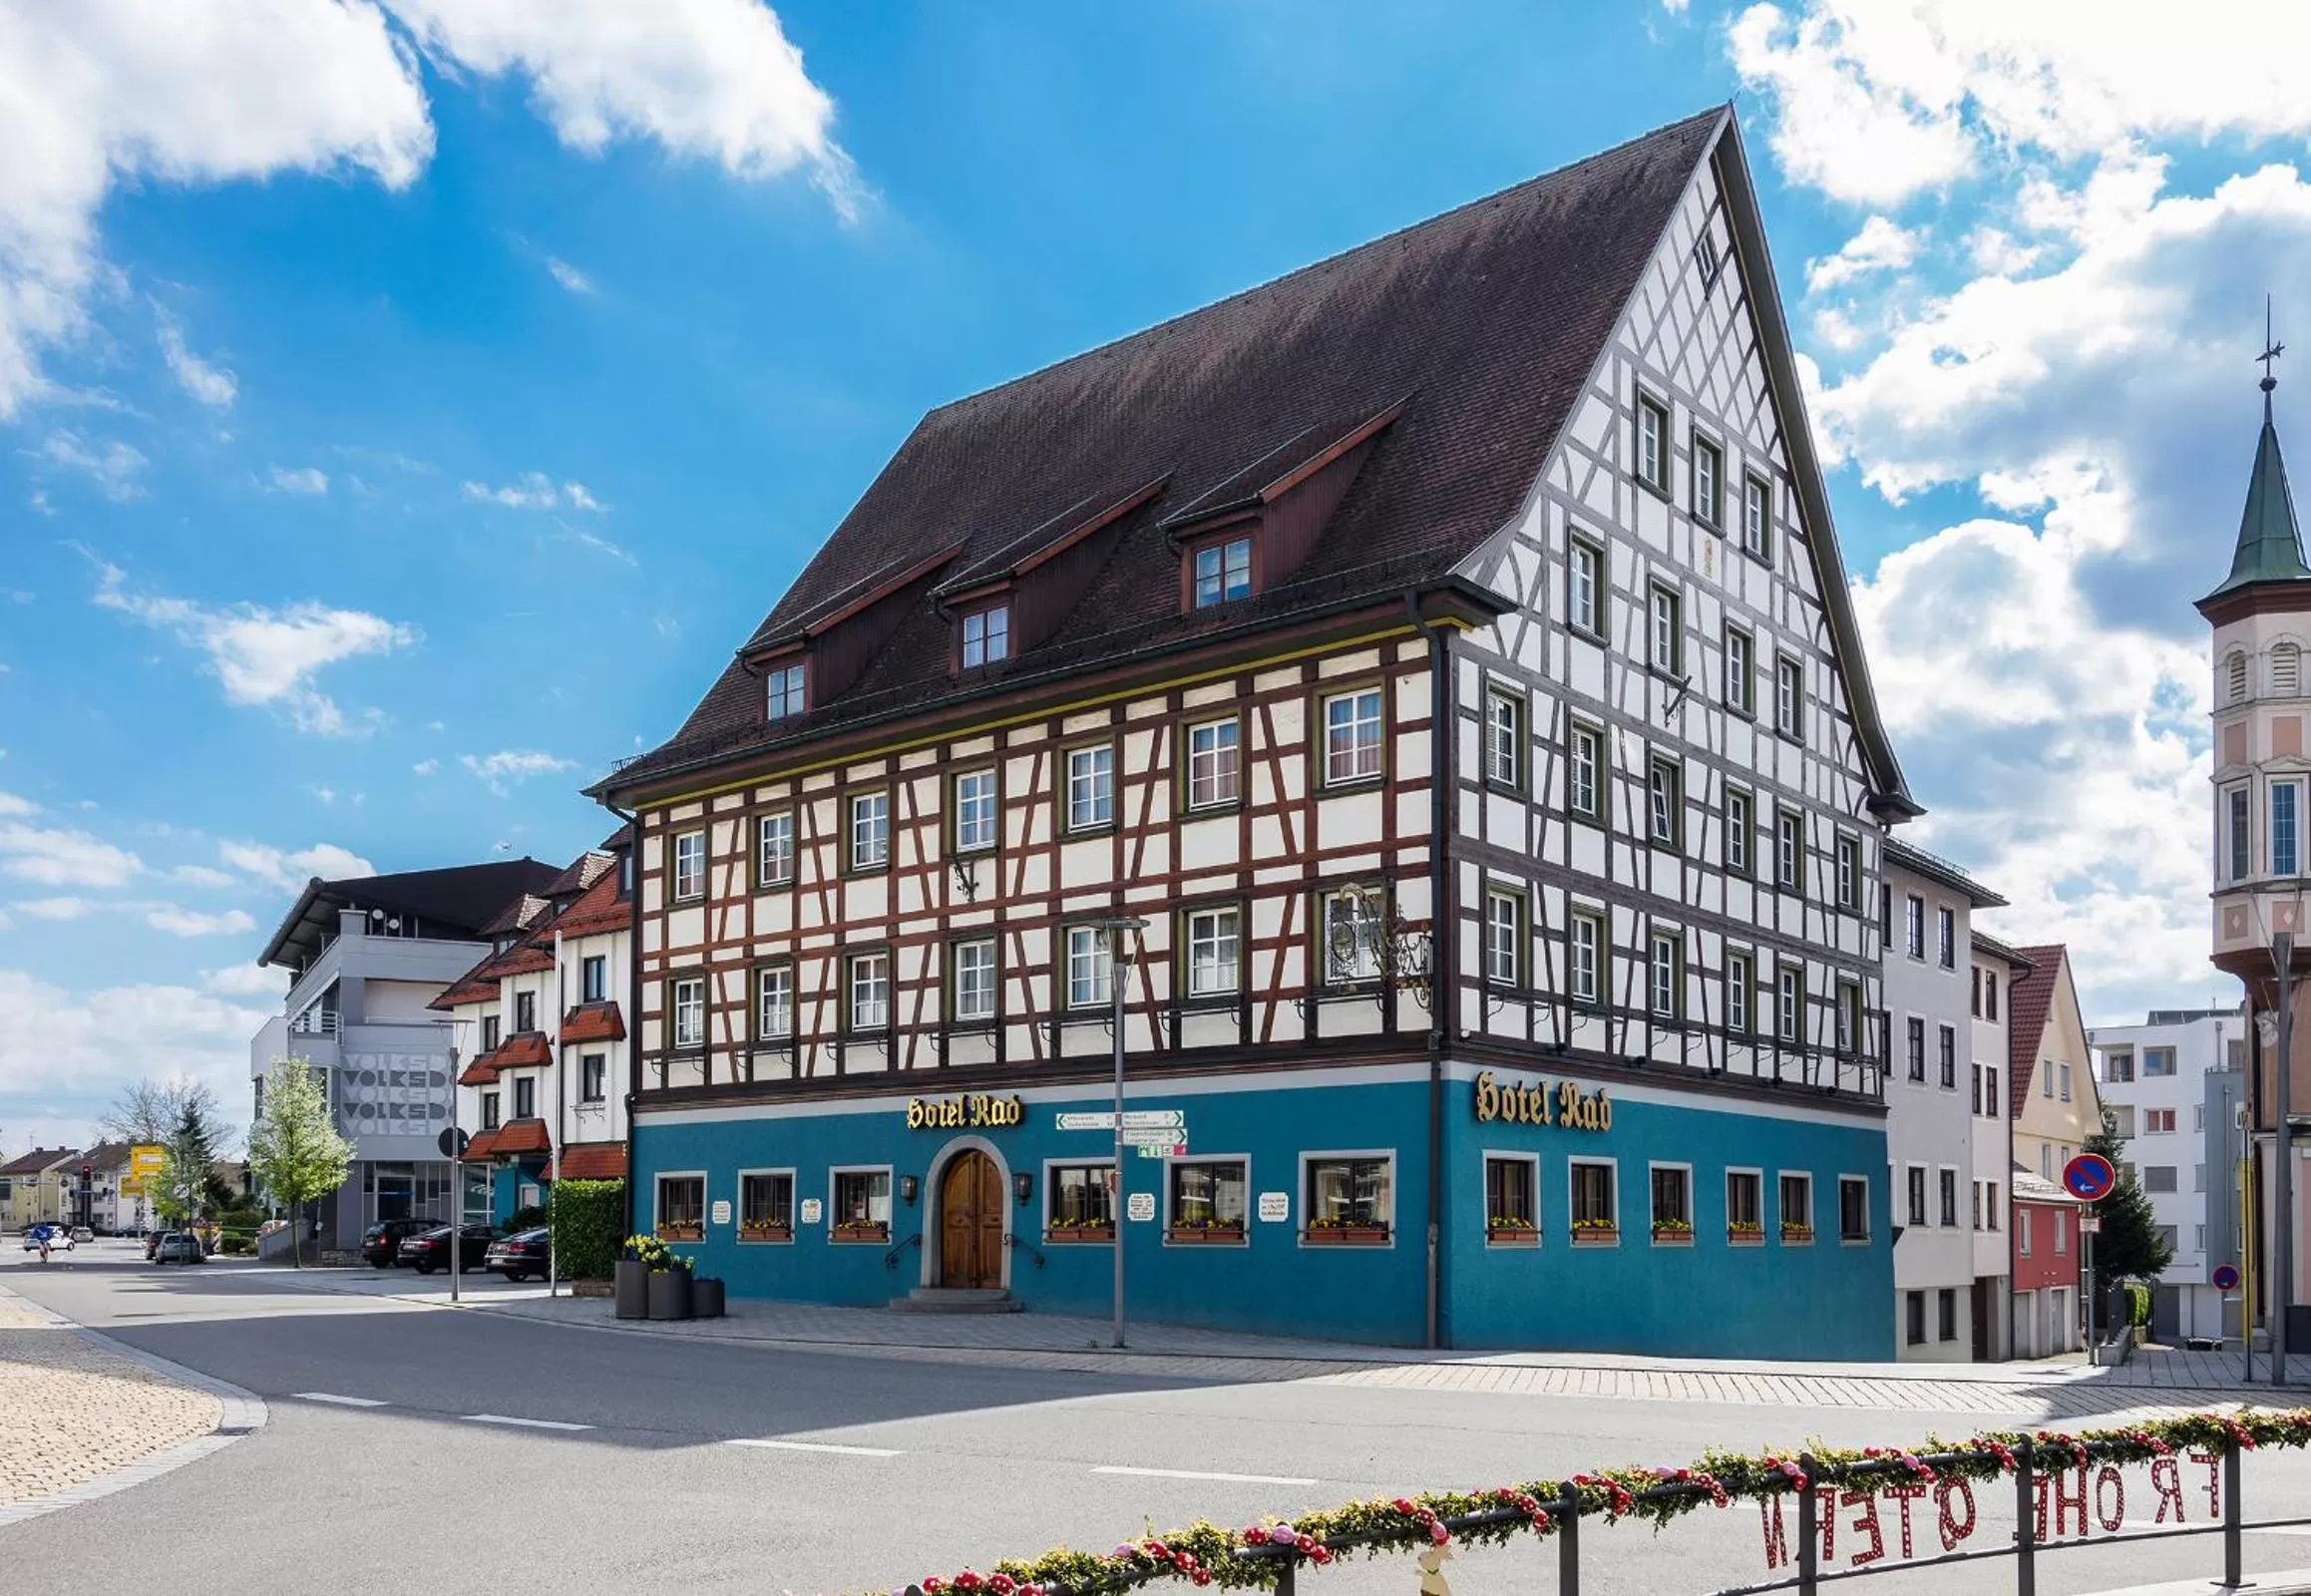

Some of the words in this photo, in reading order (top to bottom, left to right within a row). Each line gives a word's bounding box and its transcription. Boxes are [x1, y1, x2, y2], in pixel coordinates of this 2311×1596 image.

[907, 1093, 966, 1129] Hotel
[969, 1094, 1021, 1126] Rad
[1476, 1070, 1552, 1124] Hotel
[1559, 1079, 1612, 1132] Rad
